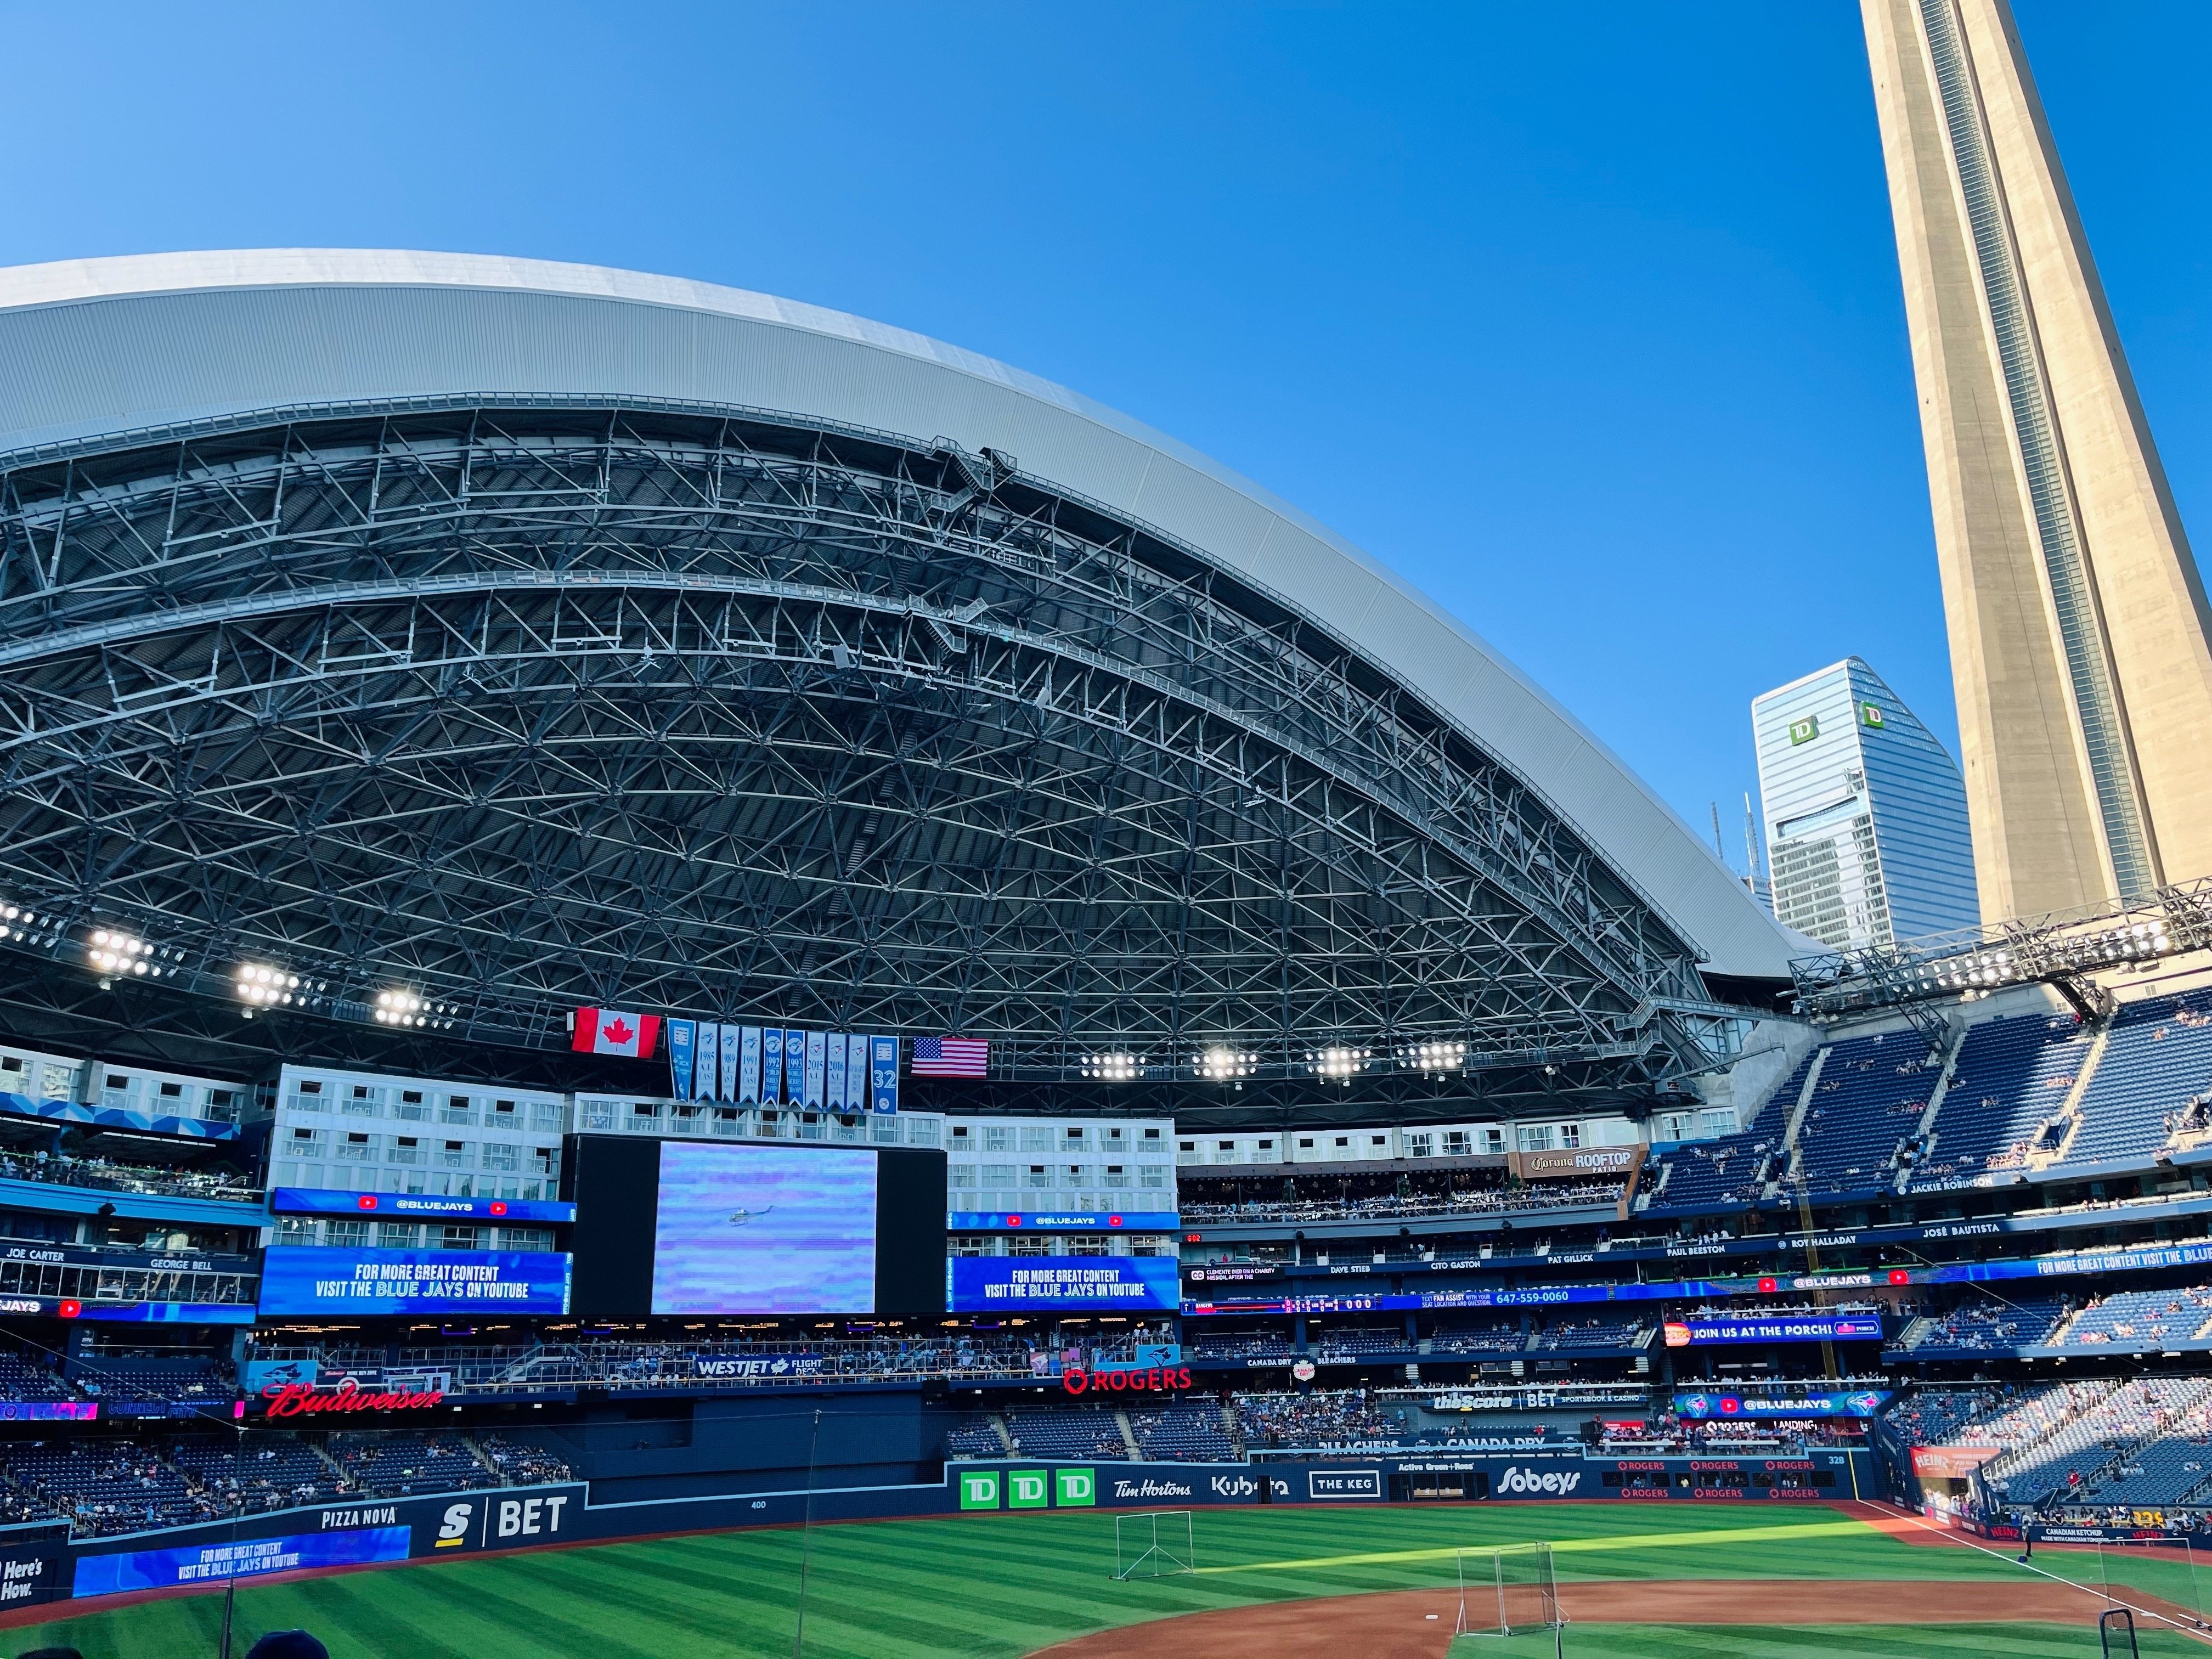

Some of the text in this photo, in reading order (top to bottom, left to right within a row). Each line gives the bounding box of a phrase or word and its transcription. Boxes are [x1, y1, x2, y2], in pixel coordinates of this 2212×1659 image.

[1866, 706, 1882, 723] TD
[1791, 722, 1811, 740] TD
[699, 1051, 714, 1061] 1985
[743, 1055, 757, 1065] 1991
[766, 1057, 780, 1068] 1992
[788, 1058, 803, 1068] 1993
[808, 1059, 823, 1070] 2015
[829, 1060, 844, 1071] 2016
[873, 1070, 896, 1088] 32
[1531, 1152, 1631, 1171] Corona ROOFTOP
[1911, 1182, 1942, 1194] JACKIE
[1943, 1177, 1993, 1190] ROBINSON
[396, 1200, 473, 1211] @BLUEJAYS
[1036, 1216, 1096, 1225] @BLUEJAYS
[1923, 1224, 2000, 1238] JOSÉ BAUTISTA
[1791, 1239, 1809, 1248] ROY
[1811, 1235, 1856, 1246] HALLADAY
[6, 1249, 64, 1261] JOE CARTER
[1667, 1245, 1725, 1257] PAUL BEESTON
[151, 1259, 212, 1271] GEORGE BELL
[1451, 1261, 1481, 1269] GASTON
[1564, 1254, 1593, 1263] GILLICK
[2037, 1250, 2182, 1274] FOR MORE GREAT CONTENT VISIT THE
[356, 1264, 499, 1281] FOR MORE GREAT CONTENT
[1012, 1269, 1119, 1283] FOR MORE GREAT CONTENT
[1793, 1274, 1871, 1288] @BLUEJAYS
[316, 1281, 528, 1299] VISIT THE BLUE JAYS ON YOUTUBE
[985, 1283, 1145, 1297] VISIT THE BLUE JAYS ON YOUTUBE
[1497, 1291, 1568, 1304] 647-559-0060
[1694, 1329, 1718, 1339] JOIN
[1722, 1328, 1736, 1338] US
[1741, 1327, 1755, 1336] AT
[1759, 1326, 1781, 1336] THE
[1785, 1324, 1832, 1335] PORCH!
[698, 1360, 770, 1377] WESTJET
[792, 1359, 822, 1368] FLIGHT
[1095, 1368, 1191, 1391] ROGERS
[262, 1383, 445, 1417] Budweiser
[1434, 1396, 1513, 1409] theScore
[1527, 1393, 1556, 1408] BET
[1744, 1400, 1831, 1409] @BLUEJAYS
[1398, 1463, 1423, 1471] Active
[1629, 1462, 1664, 1470] ROGERS
[1702, 1462, 1739, 1470] ROGERS
[1777, 1462, 1815, 1470] ROGERS
[1915, 1454, 1949, 1468] HEINZ
[1060, 1476, 1091, 1498] TD
[1318, 1479, 1372, 1489] THE KEG
[1497, 1467, 1581, 1495] Sobeys
[965, 1479, 996, 1502] TD
[1013, 1477, 1043, 1500] TD
[1114, 1479, 1191, 1498] Tim Hortons
[1632, 1489, 1668, 1498] ROGERS
[1705, 1489, 1742, 1497] ROGERS
[1781, 1489, 1819, 1498] ROGERS
[321, 1506, 396, 1529] PIZZA NOVA
[498, 1496, 568, 1537] BET
[1990, 1526, 2019, 1538] HEINZ
[201, 1542, 282, 1563] FOR MORE GREAT CONTENT
[4, 1558, 42, 1579] Here's
[178, 1567, 196, 1579] VISIT
[198, 1564, 210, 1577] THE
[237, 1555, 260, 1572] JAYS
[262, 1556, 272, 1569] ON
[273, 1553, 299, 1567] YOUTUBE
[1, 1582, 32, 1601] How.
